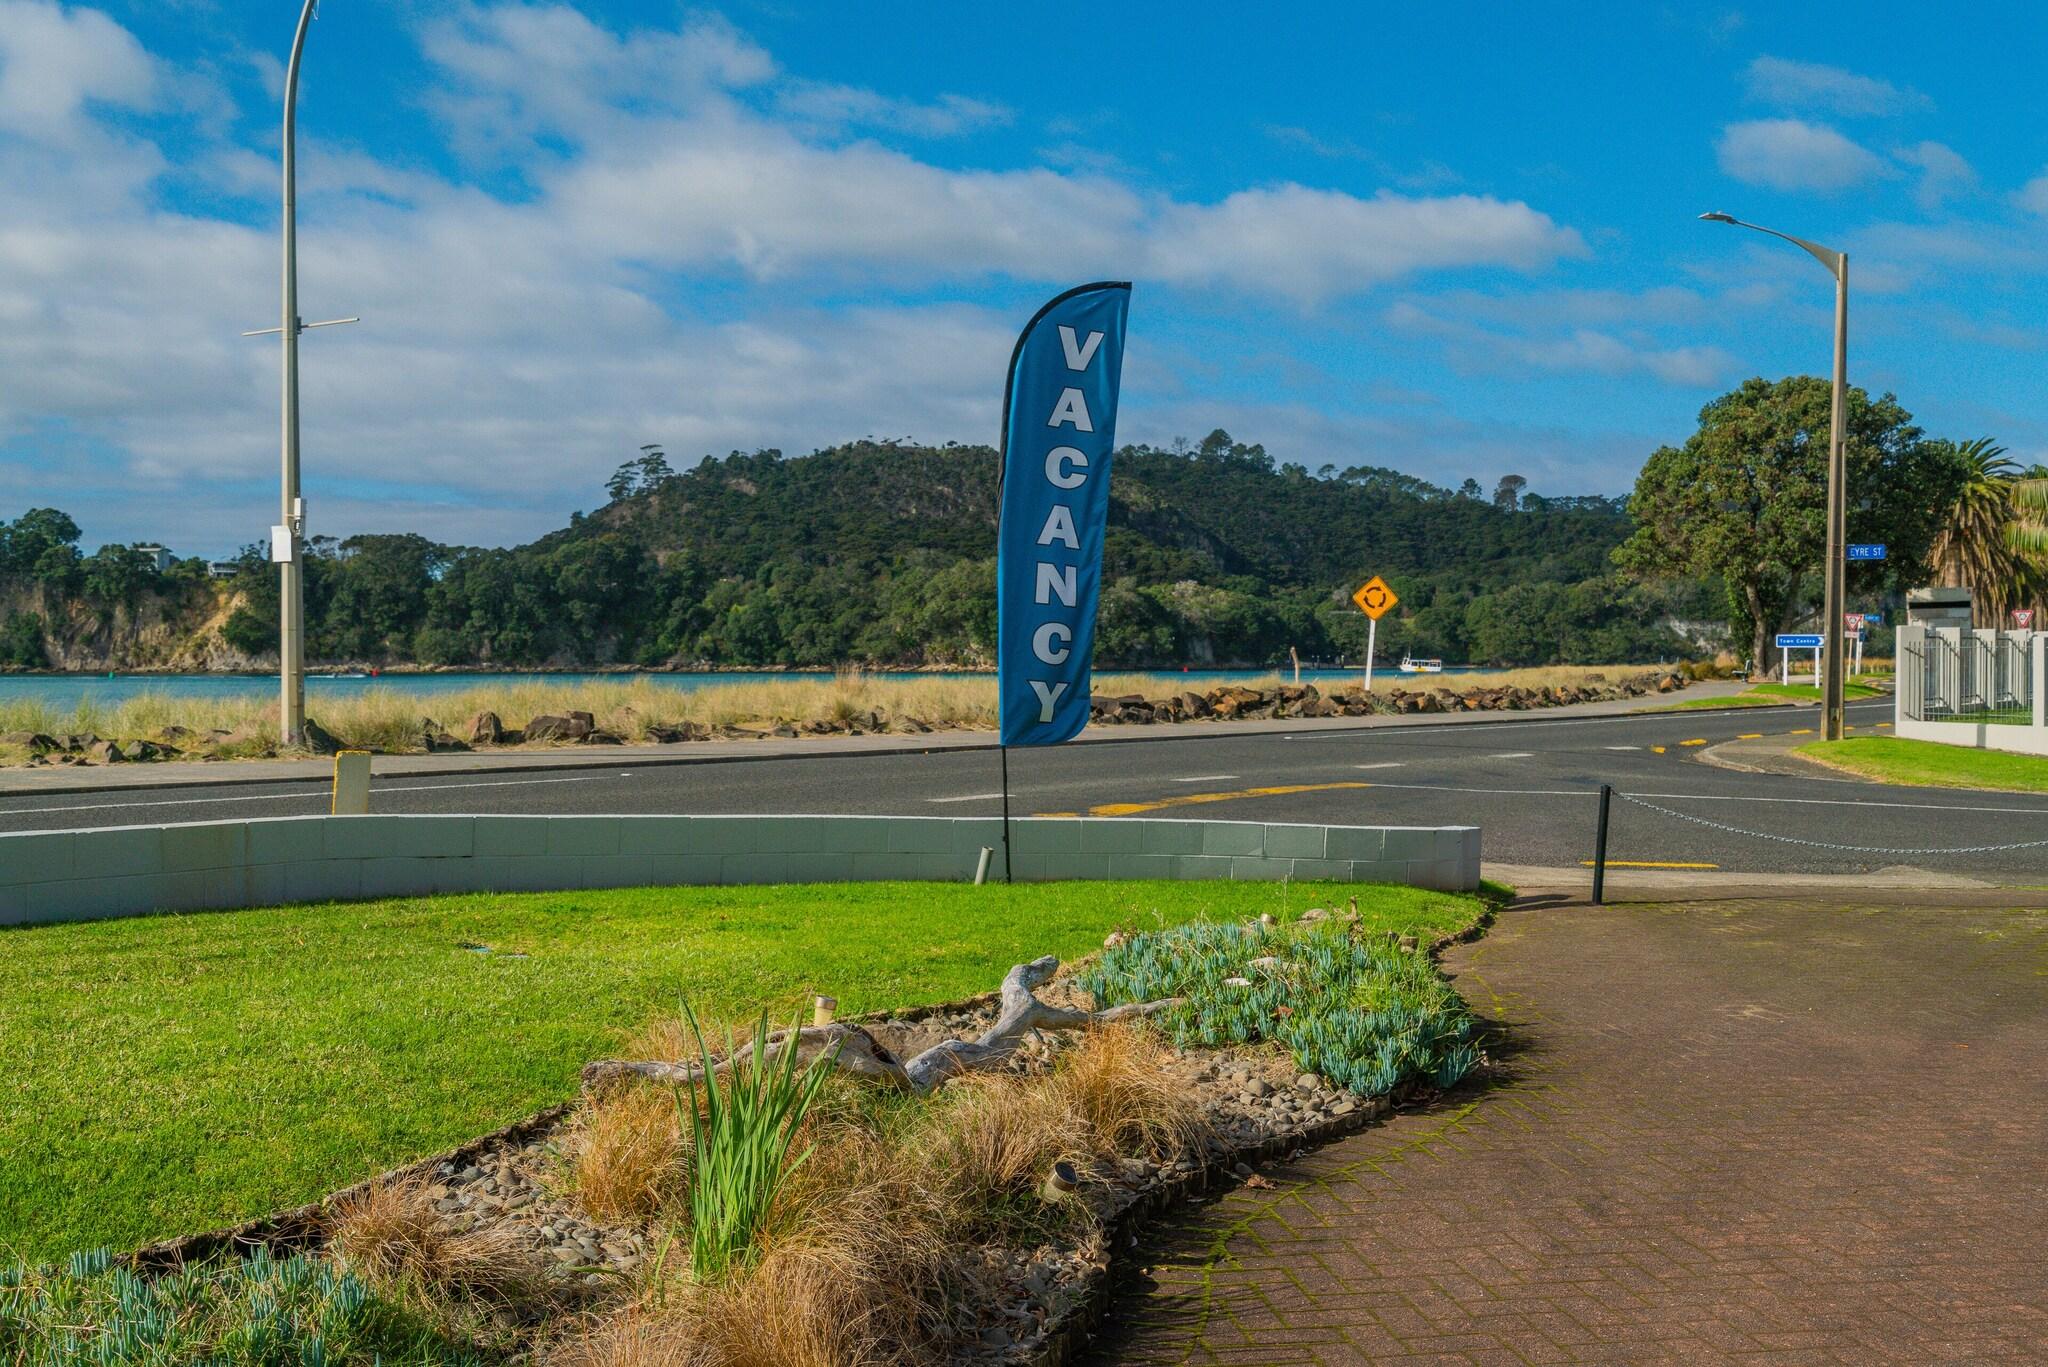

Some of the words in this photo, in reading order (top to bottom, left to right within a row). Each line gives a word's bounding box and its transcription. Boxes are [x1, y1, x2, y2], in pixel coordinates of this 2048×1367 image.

[1027, 324, 1105, 723] VACANCY
[1850, 547, 1870, 557] EYRE
[1872, 547, 1882, 556] ST
